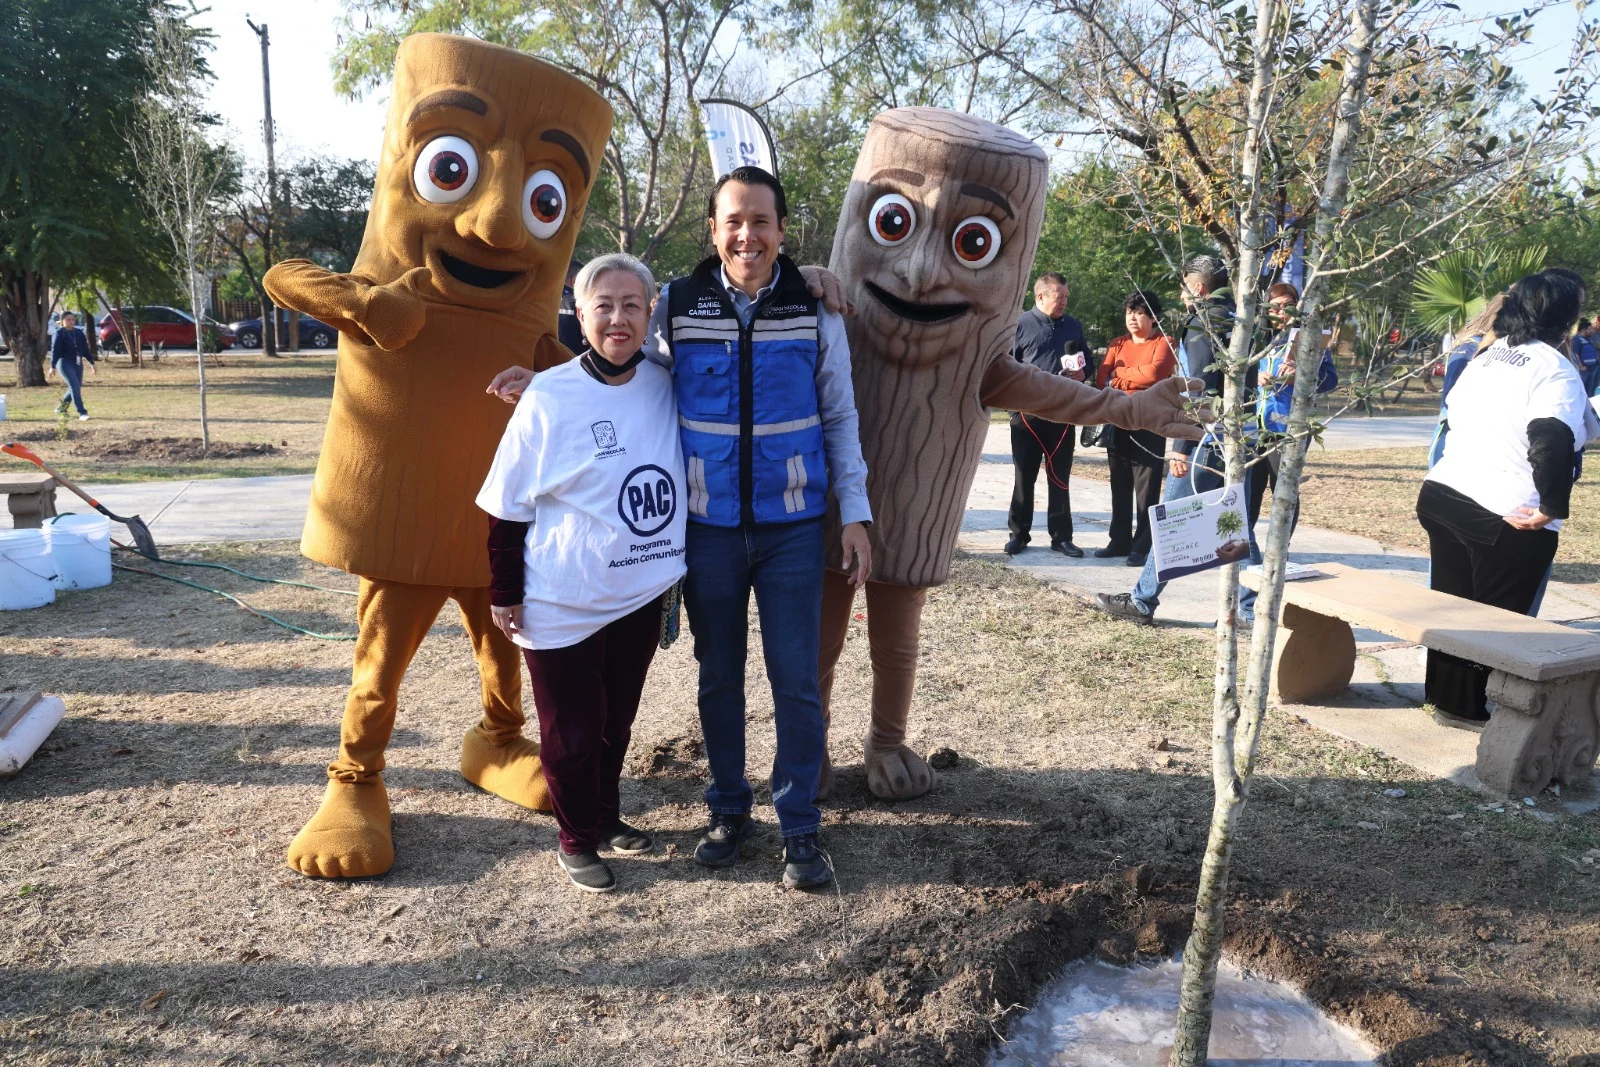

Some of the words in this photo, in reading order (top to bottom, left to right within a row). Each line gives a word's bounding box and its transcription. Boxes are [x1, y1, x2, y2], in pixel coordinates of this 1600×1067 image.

[697, 301, 722, 309] DANIEL
[627, 478, 671, 522] PAC
[630, 538, 672, 553] Programa
[608, 556, 639, 568] Acción
